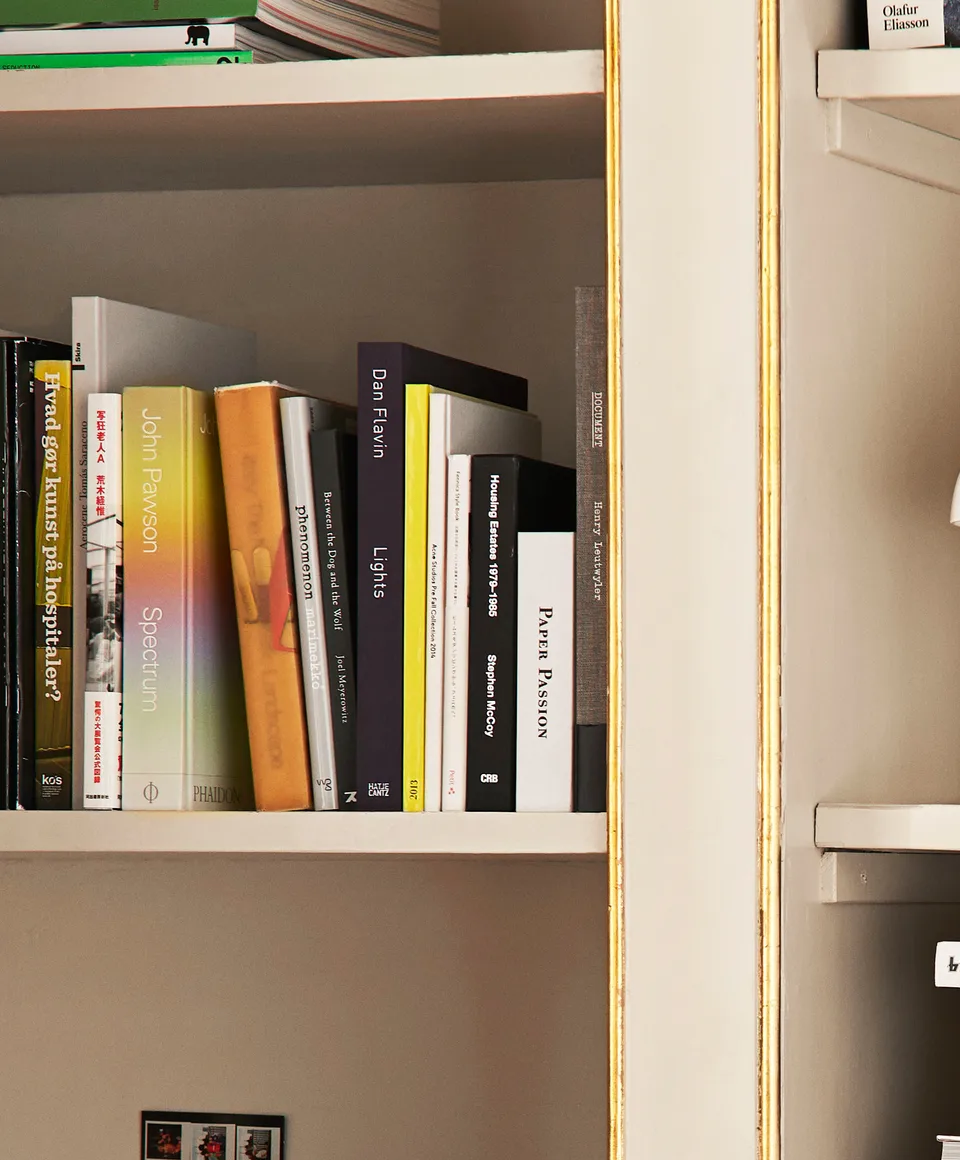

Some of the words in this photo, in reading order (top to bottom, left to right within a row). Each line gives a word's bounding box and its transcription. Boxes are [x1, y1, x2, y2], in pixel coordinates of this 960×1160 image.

[882, 4, 919, 18] Olafur
[883, 17, 929, 31] Eliasson
[74, 342, 82, 362] Skira
[42, 372, 62, 431] Hvad
[372, 367, 388, 403] Dan
[140, 408, 161, 462] John
[372, 407, 389, 459] Flavin
[592, 391, 604, 448] DOCUMENT
[39, 435, 62, 475] gør
[42, 477, 62, 541] kunst
[141, 467, 163, 554] Pawson
[324, 491, 335, 528] Between
[486, 474, 500, 518] Housing
[592, 501, 604, 536] Henry
[326, 531, 336, 547] the
[487, 520, 500, 561] Estates
[39, 544, 62, 573] på
[326, 549, 338, 569] Dog
[369, 546, 388, 599] Lights
[592, 541, 604, 601] Leutwyler
[295, 505, 315, 601] phenomenon
[305, 607, 322, 690] marimekko
[329, 571, 340, 589] and
[331, 591, 341, 606] the
[332, 608, 344, 631] Wolf
[430, 609, 438, 642] Collection
[537, 606, 555, 661] PAPER
[39, 577, 62, 702] hospitaler?
[139, 606, 163, 712] Spectrum
[335, 654, 346, 672] Joel
[484, 654, 499, 697] Stephen
[337, 674, 349, 724] Meyerowitz
[537, 667, 555, 740] PASSION
[483, 699, 498, 738] McCoy
[41, 774, 63, 785] kos
[368, 782, 389, 790] HATJE
[368, 789, 389, 797] CANTZ
[409, 779, 418, 801] 2013
[479, 773, 499, 784] CRB
